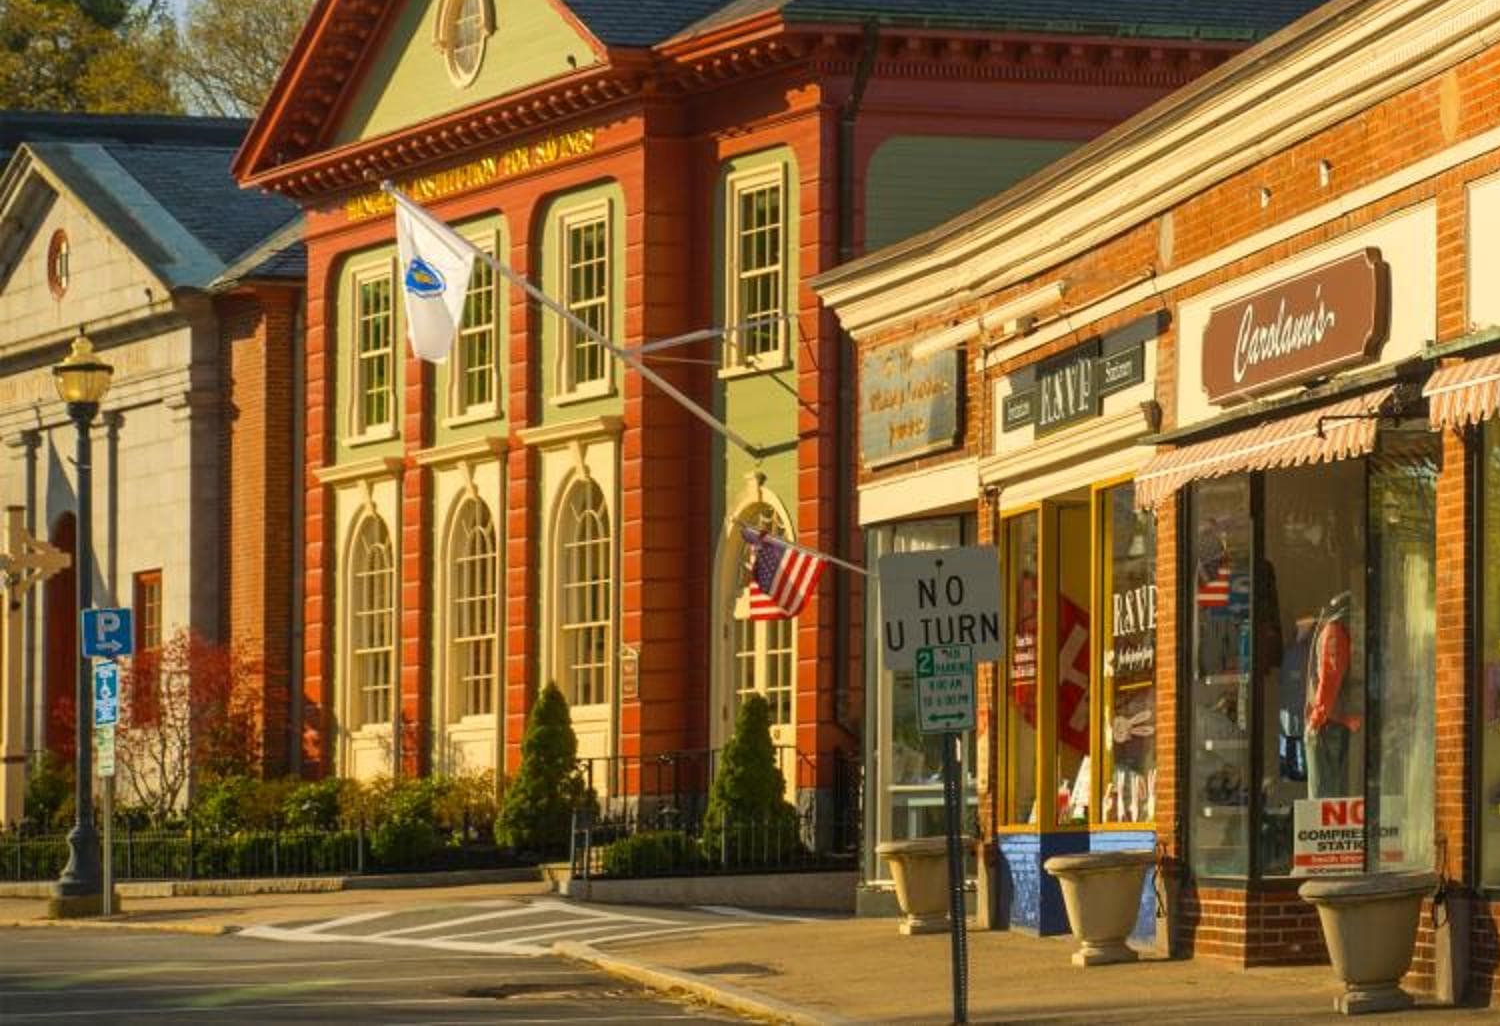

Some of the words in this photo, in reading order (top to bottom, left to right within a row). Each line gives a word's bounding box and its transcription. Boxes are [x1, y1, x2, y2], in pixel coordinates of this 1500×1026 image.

[1040, 358, 1092, 425] RSVP
[917, 574, 965, 609] NO
[96, 611, 121, 642] P
[885, 620, 905, 651] U
[920, 611, 999, 647] TURN
